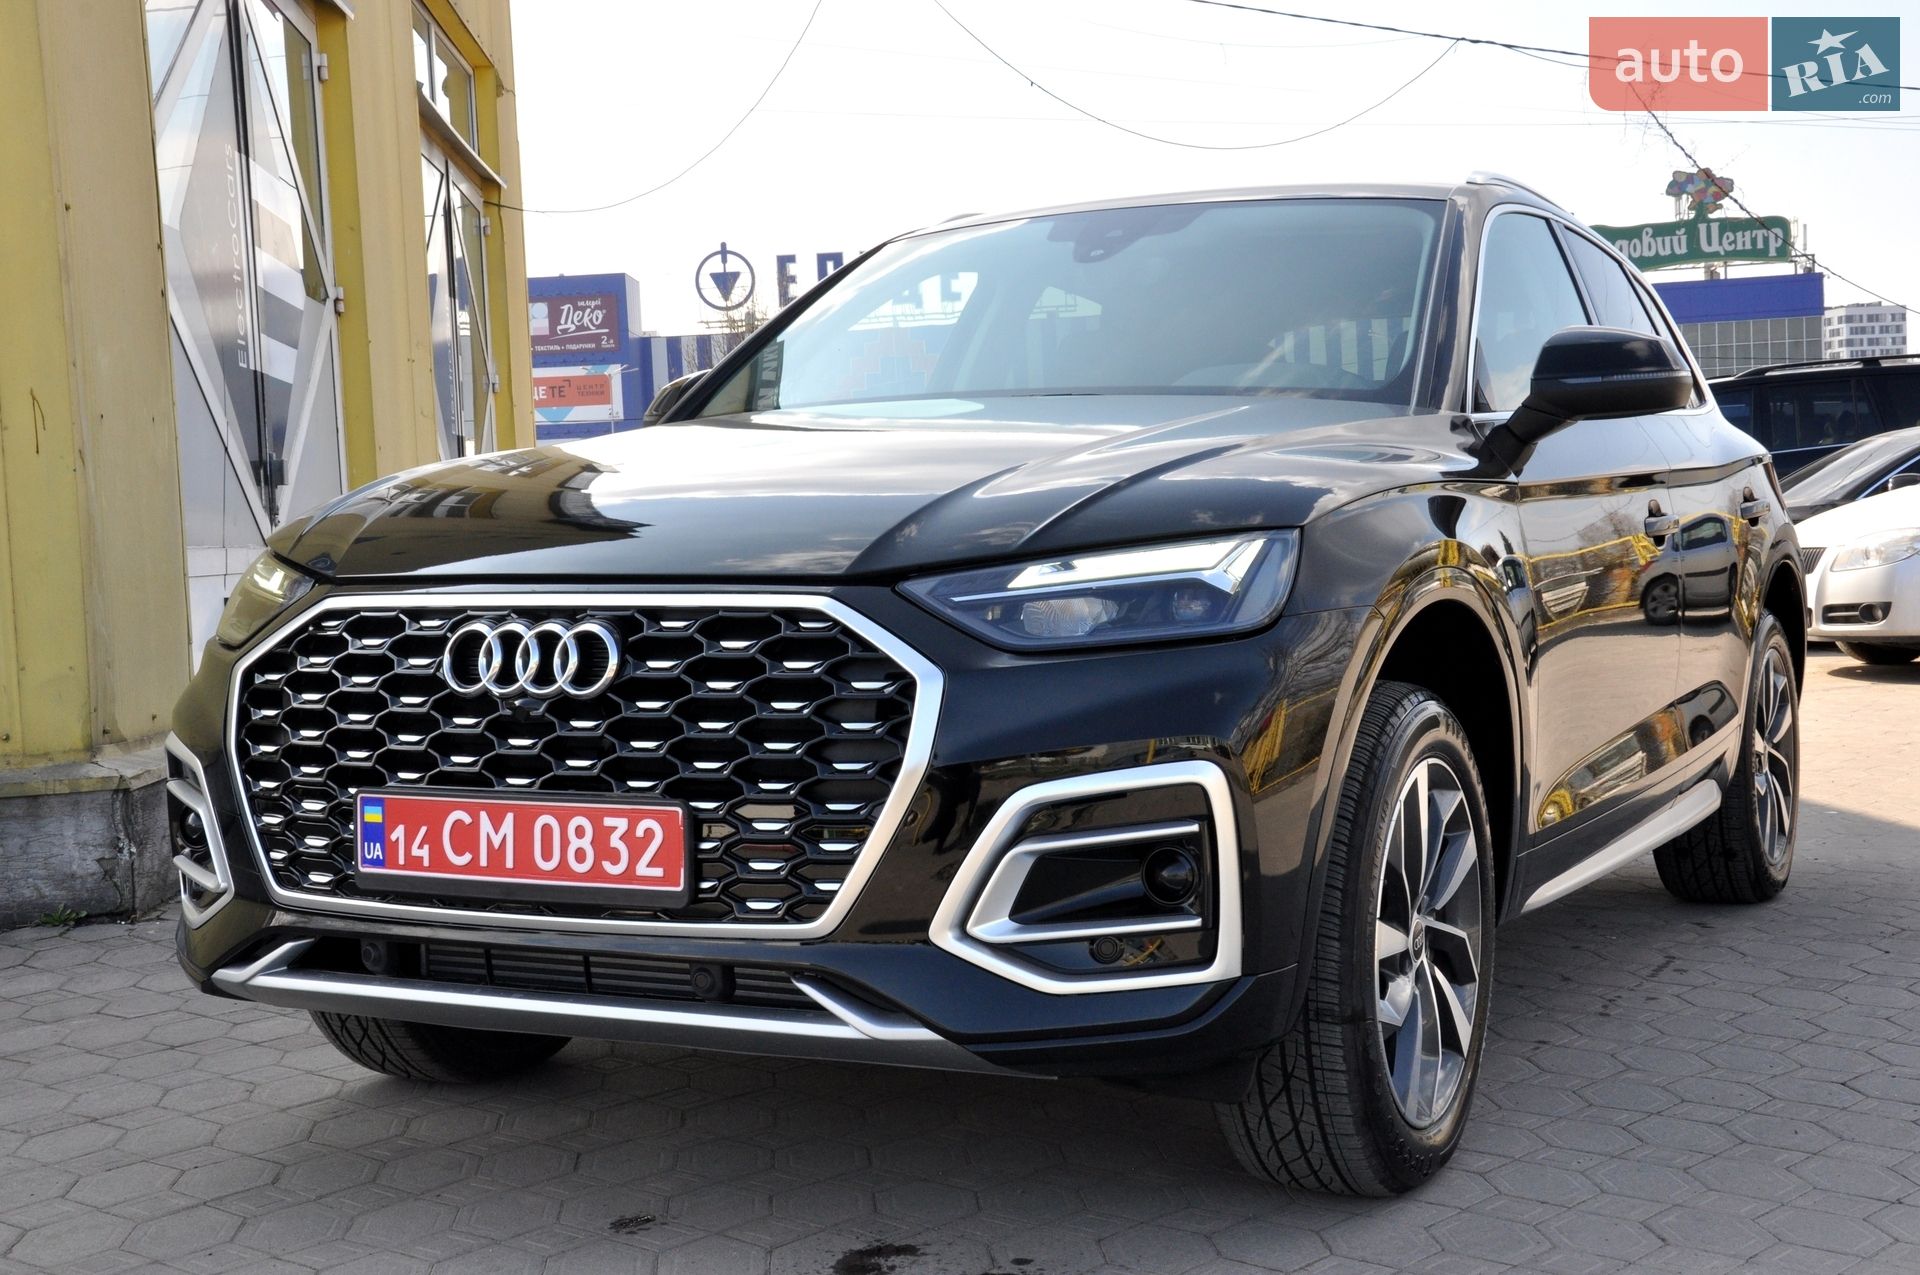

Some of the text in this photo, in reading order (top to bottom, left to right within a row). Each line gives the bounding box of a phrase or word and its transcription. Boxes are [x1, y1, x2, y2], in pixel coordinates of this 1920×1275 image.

[1698, 221, 1784, 258] Центр
[225, 143, 248, 369] ElectroCars
[556, 303, 603, 334] Деко
[534, 344, 561, 352] ТЕКСТИЛЬ
[549, 385, 566, 398] ТЕ
[364, 842, 383, 860] UA
[390, 810, 665, 878] 14 CM 0832
